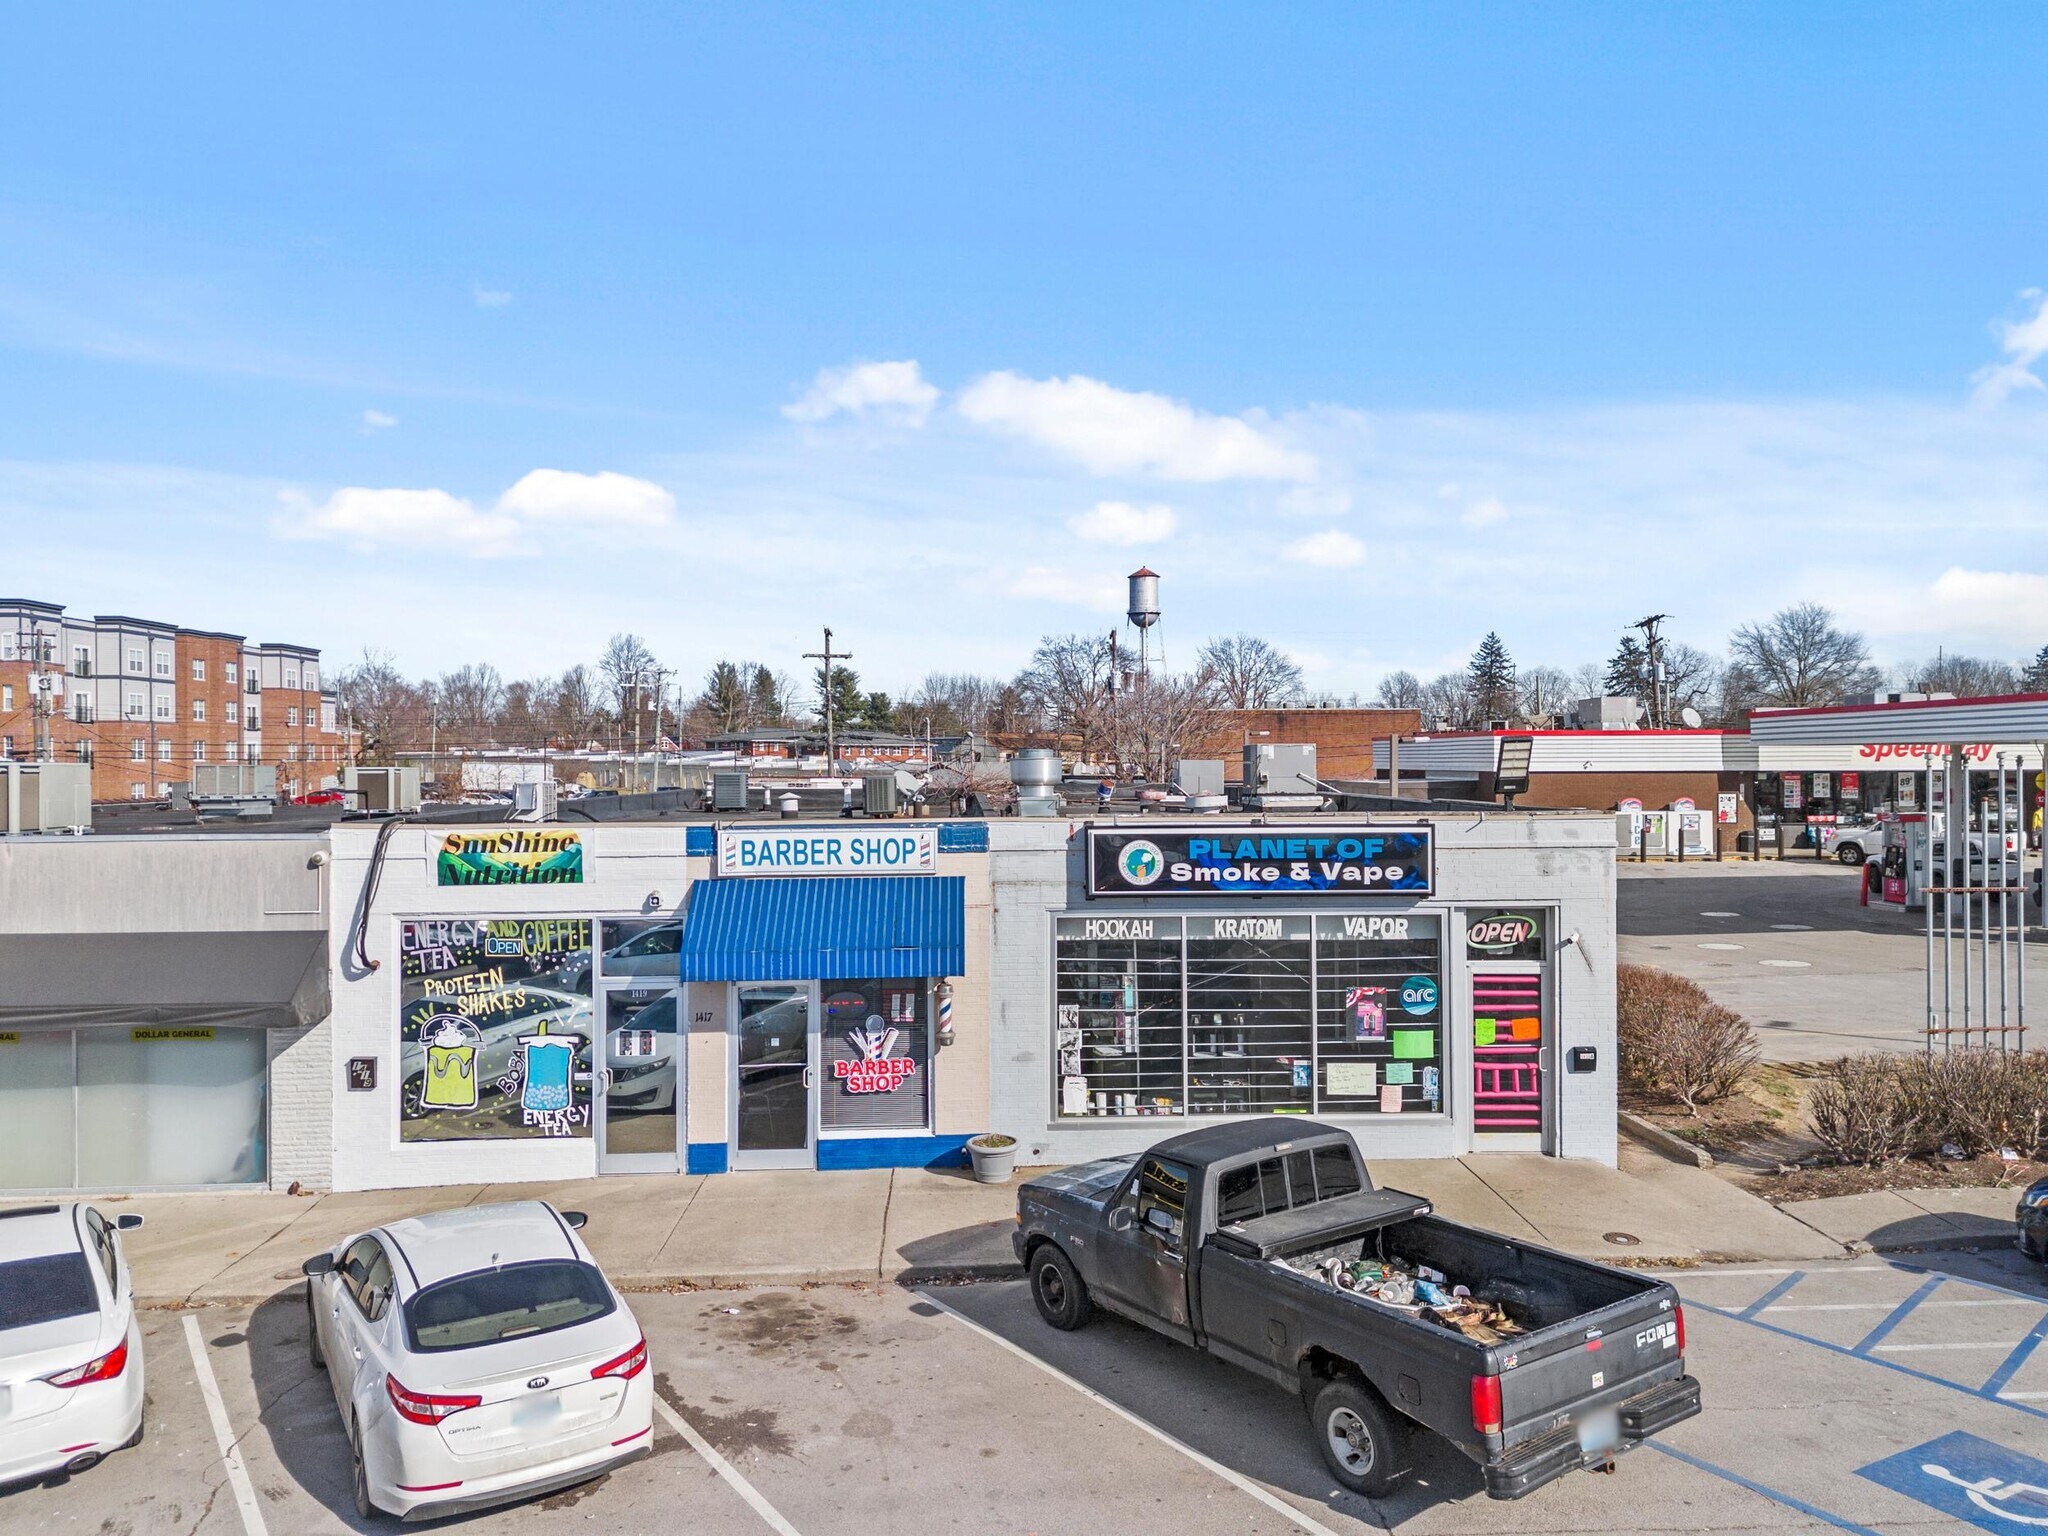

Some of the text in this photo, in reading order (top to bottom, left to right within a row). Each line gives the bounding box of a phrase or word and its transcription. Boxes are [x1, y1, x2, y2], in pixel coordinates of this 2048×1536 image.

[1859, 743, 1994, 762] Speeday
[444, 831, 574, 854] SunShine
[741, 838, 916, 866] BARBER SHOP
[1189, 839, 1384, 860] PLANET OF
[442, 861, 577, 886] Nutrition
[1170, 862, 1280, 881] Smoke
[1290, 863, 1311, 881] &
[1320, 862, 1404, 882] Vape
[1085, 919, 1154, 938] HOOKAH
[1214, 919, 1283, 938] KRATOM
[1344, 917, 1409, 939] VAPOR
[1471, 923, 1529, 942] OPEN
[401, 920, 592, 956] ENERGY AND COFFEE
[488, 938, 521, 954] OPEN
[410, 946, 458, 973] TEA
[424, 966, 505, 998] PROTEIN
[457, 987, 526, 1016] SHAKES
[631, 990, 648, 998] 1419
[1402, 988, 1436, 1003] arc
[695, 1012, 714, 1022] 1417
[172, 1030, 211, 1038] GENERAL
[496, 1049, 525, 1098] BOBA
[834, 1059, 915, 1078] BARBER
[847, 1075, 903, 1093] SHOP
[523, 1104, 589, 1128] ENERGY
[539, 1122, 572, 1136] TEA
[1635, 1321, 1676, 1348] FORD
[530, 1377, 547, 1389] KIA
[448, 1425, 481, 1435] OPTIMA
